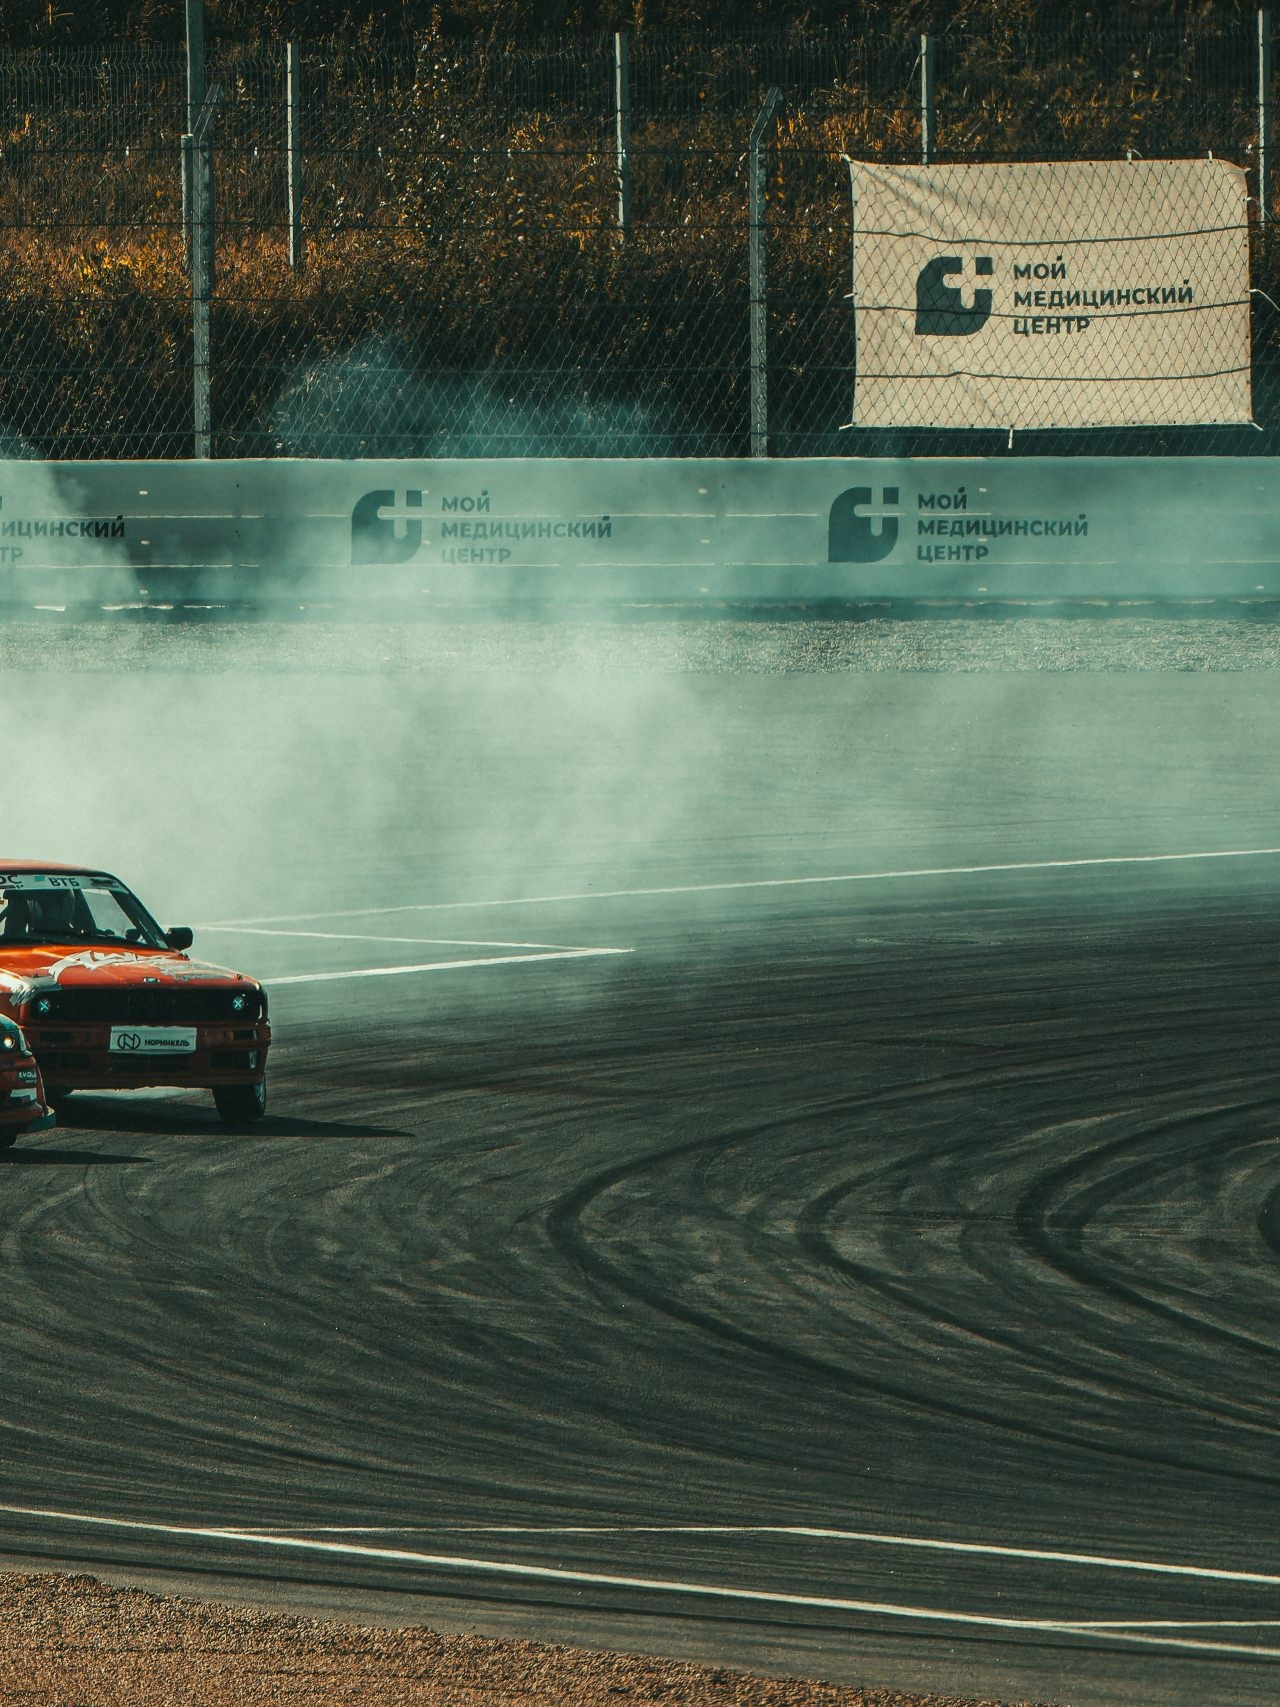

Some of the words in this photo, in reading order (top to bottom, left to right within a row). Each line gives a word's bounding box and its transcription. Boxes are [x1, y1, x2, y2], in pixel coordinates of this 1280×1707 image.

[1013, 255, 1066, 280] МОЙ
[1013, 279, 1193, 309] МЕДИЦИНСКИЙ
[1013, 316, 1091, 337] ЦЕНТР
[441, 490, 490, 513] МОЙ
[918, 486, 968, 510] МОЙ
[441, 516, 612, 539] МЕДИЦИНСКИЙ
[917, 514, 1089, 538] МЕДИЦИНСКИЙ
[441, 548, 511, 564] ЦЕНТР
[917, 544, 989, 563] ЦЕНТР
